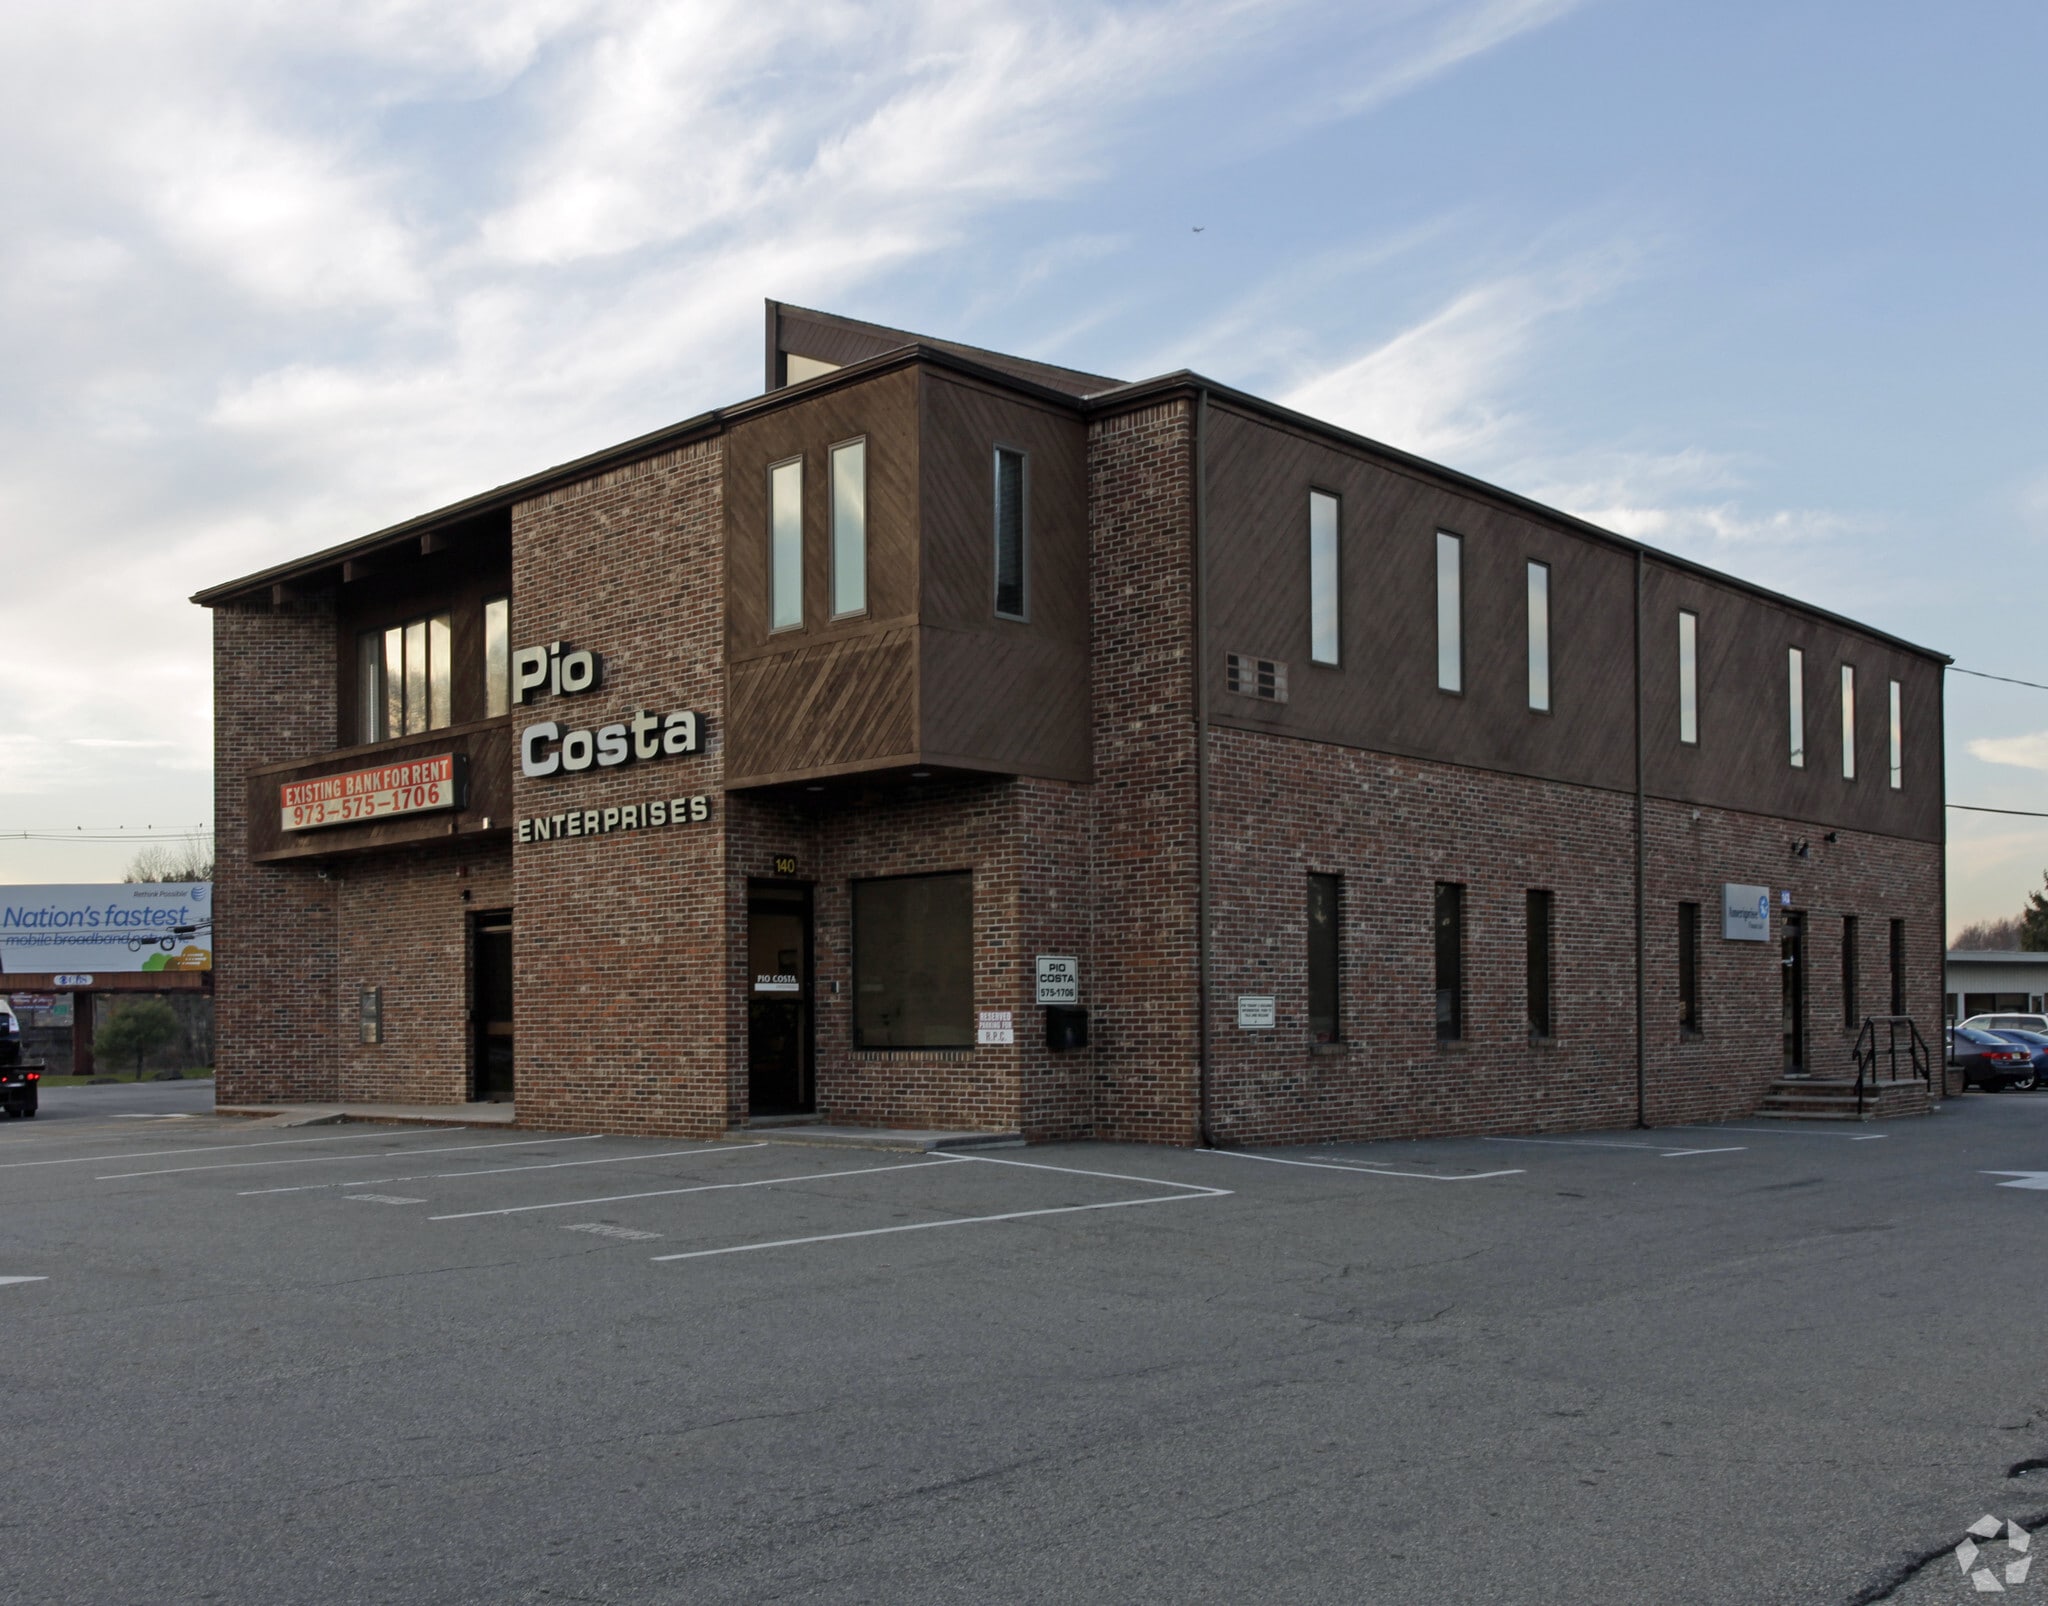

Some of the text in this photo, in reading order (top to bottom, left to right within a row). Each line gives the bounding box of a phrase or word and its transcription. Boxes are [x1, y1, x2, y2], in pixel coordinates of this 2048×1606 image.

[513, 641, 596, 704] Pio
[521, 710, 699, 777] Costa
[285, 759, 449, 806] EXISTING BANK FOR RENT
[293, 782, 440, 826] 973-575-1706
[518, 795, 709, 843] ENTERPRISES
[775, 858, 795, 873] 140
[3, 904, 189, 928] Nation's fastest
[6, 932, 52, 946] mobile
[53, 931, 131, 946] broadband
[1049, 963, 1066, 972] PIO
[757, 974, 797, 983] PIO COSTA
[1040, 974, 1075, 983] COSTA
[1040, 988, 1074, 997] 575-1706
